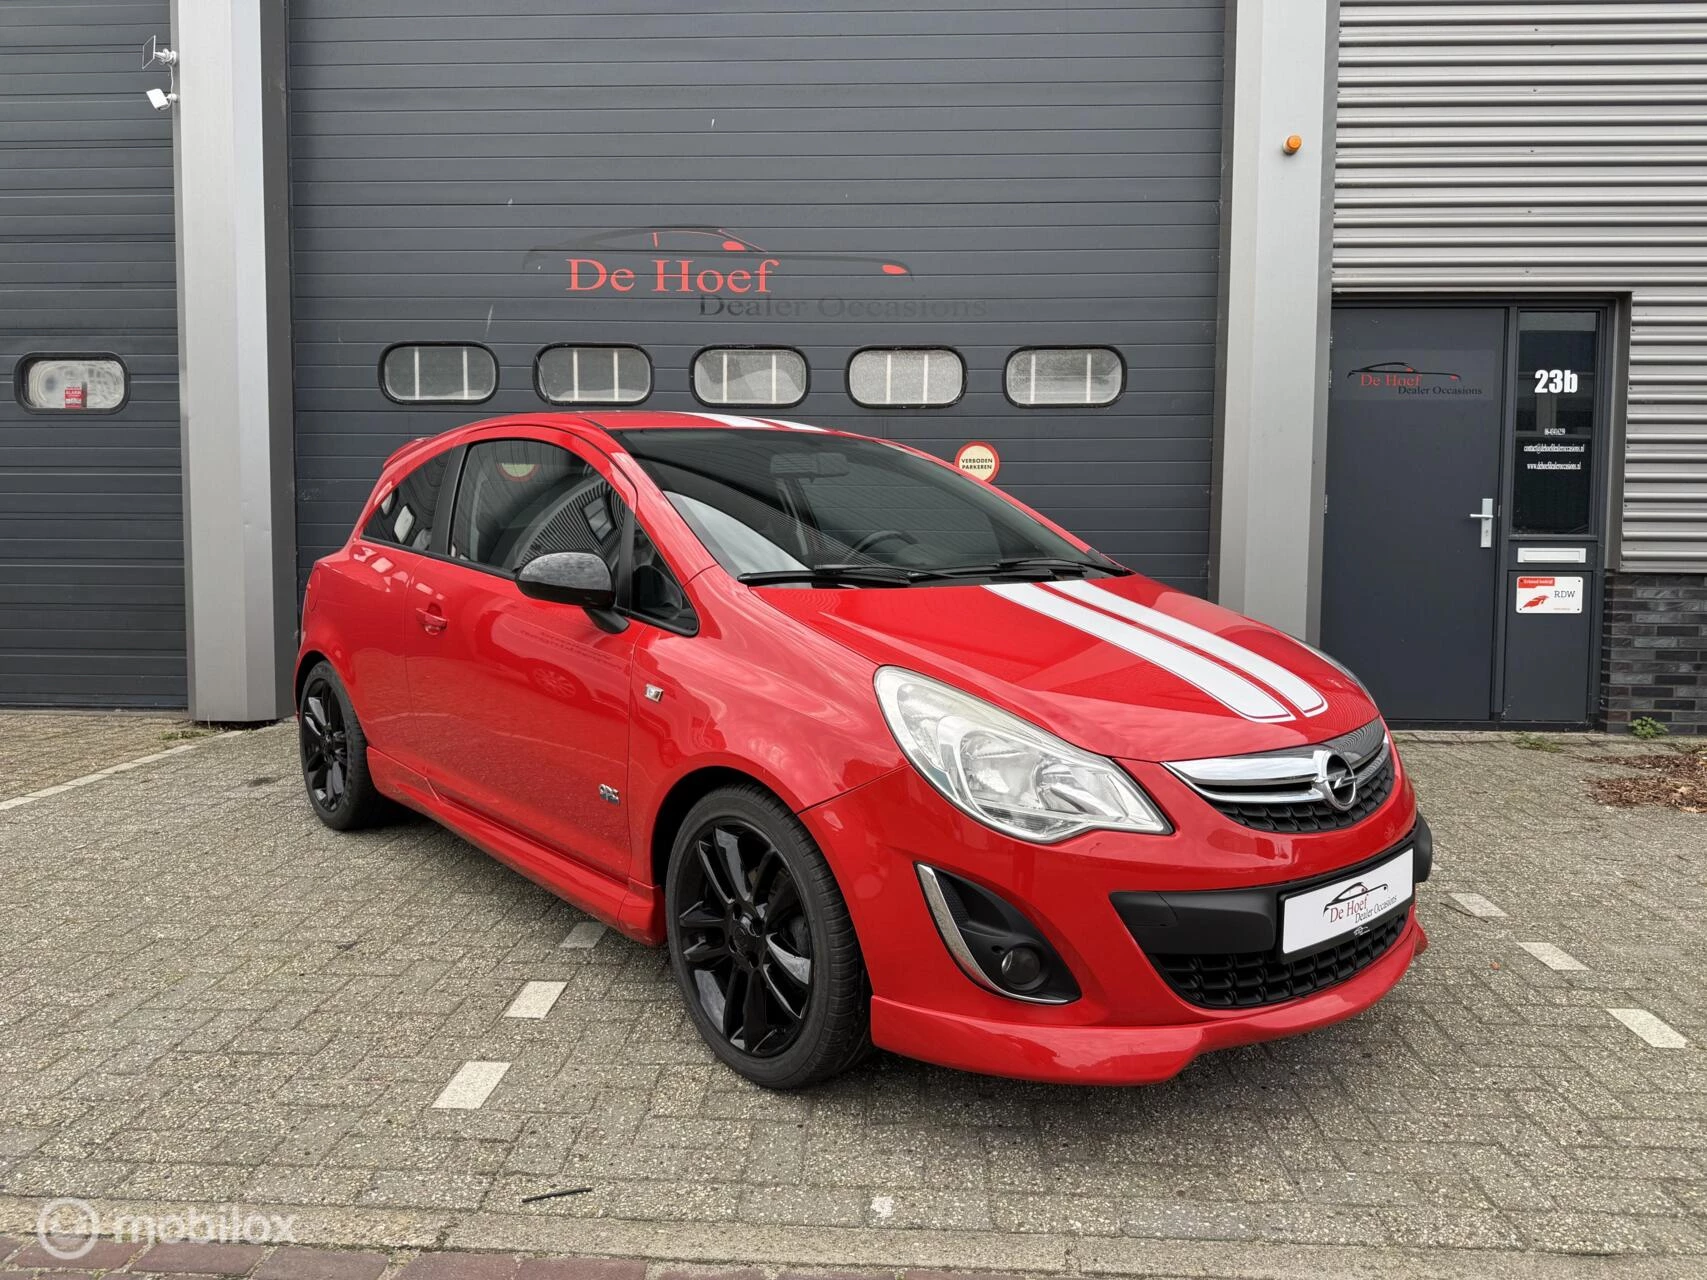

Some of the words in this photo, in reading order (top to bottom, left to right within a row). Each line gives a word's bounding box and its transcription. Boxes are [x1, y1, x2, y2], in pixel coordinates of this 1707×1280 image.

[565, 259, 635, 291] De
[651, 259, 780, 293] Hoef
[699, 295, 809, 318] Dealer
[817, 295, 988, 318] Occasions
[1361, 375, 1381, 387] De
[1385, 374, 1423, 387] Hoef
[1398, 386, 1429, 395] Dealer
[1432, 386, 1482, 395] Occasions
[1534, 369, 1578, 393] 23b
[1554, 590, 1576, 598] RDW
[1330, 907, 1344, 923] De
[1346, 894, 1369, 917] Hoef
[1355, 908, 1374, 923] Dealer
[1373, 895, 1397, 914] Occasions
